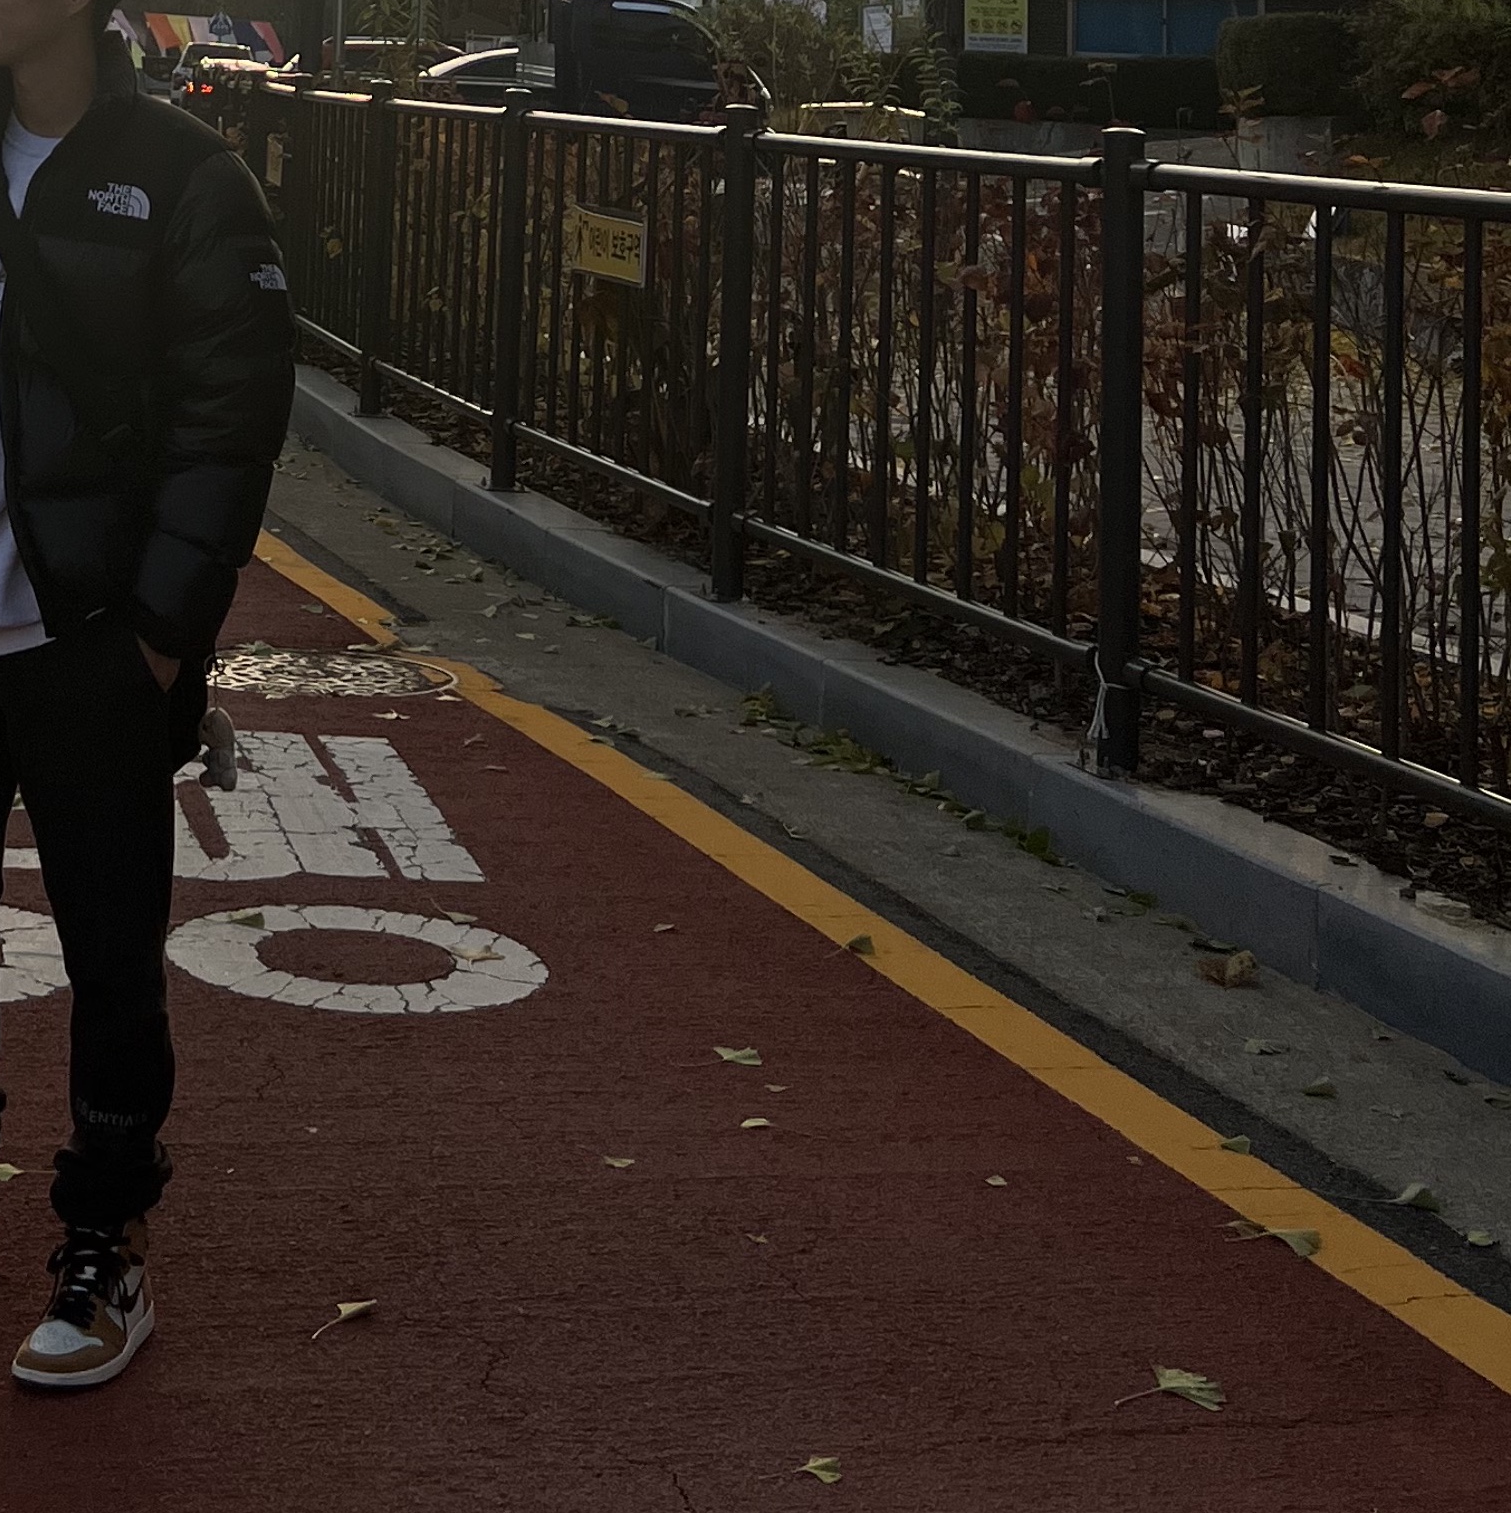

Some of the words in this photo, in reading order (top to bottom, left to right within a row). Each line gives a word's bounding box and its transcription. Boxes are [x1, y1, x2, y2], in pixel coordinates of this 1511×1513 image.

[107, 181, 132, 194] THE
[88, 189, 130, 206] NORTH
[96, 199, 129, 217] FACE
[589, 226, 609, 261] 어린이
[611, 230, 641, 267] 보호구역
